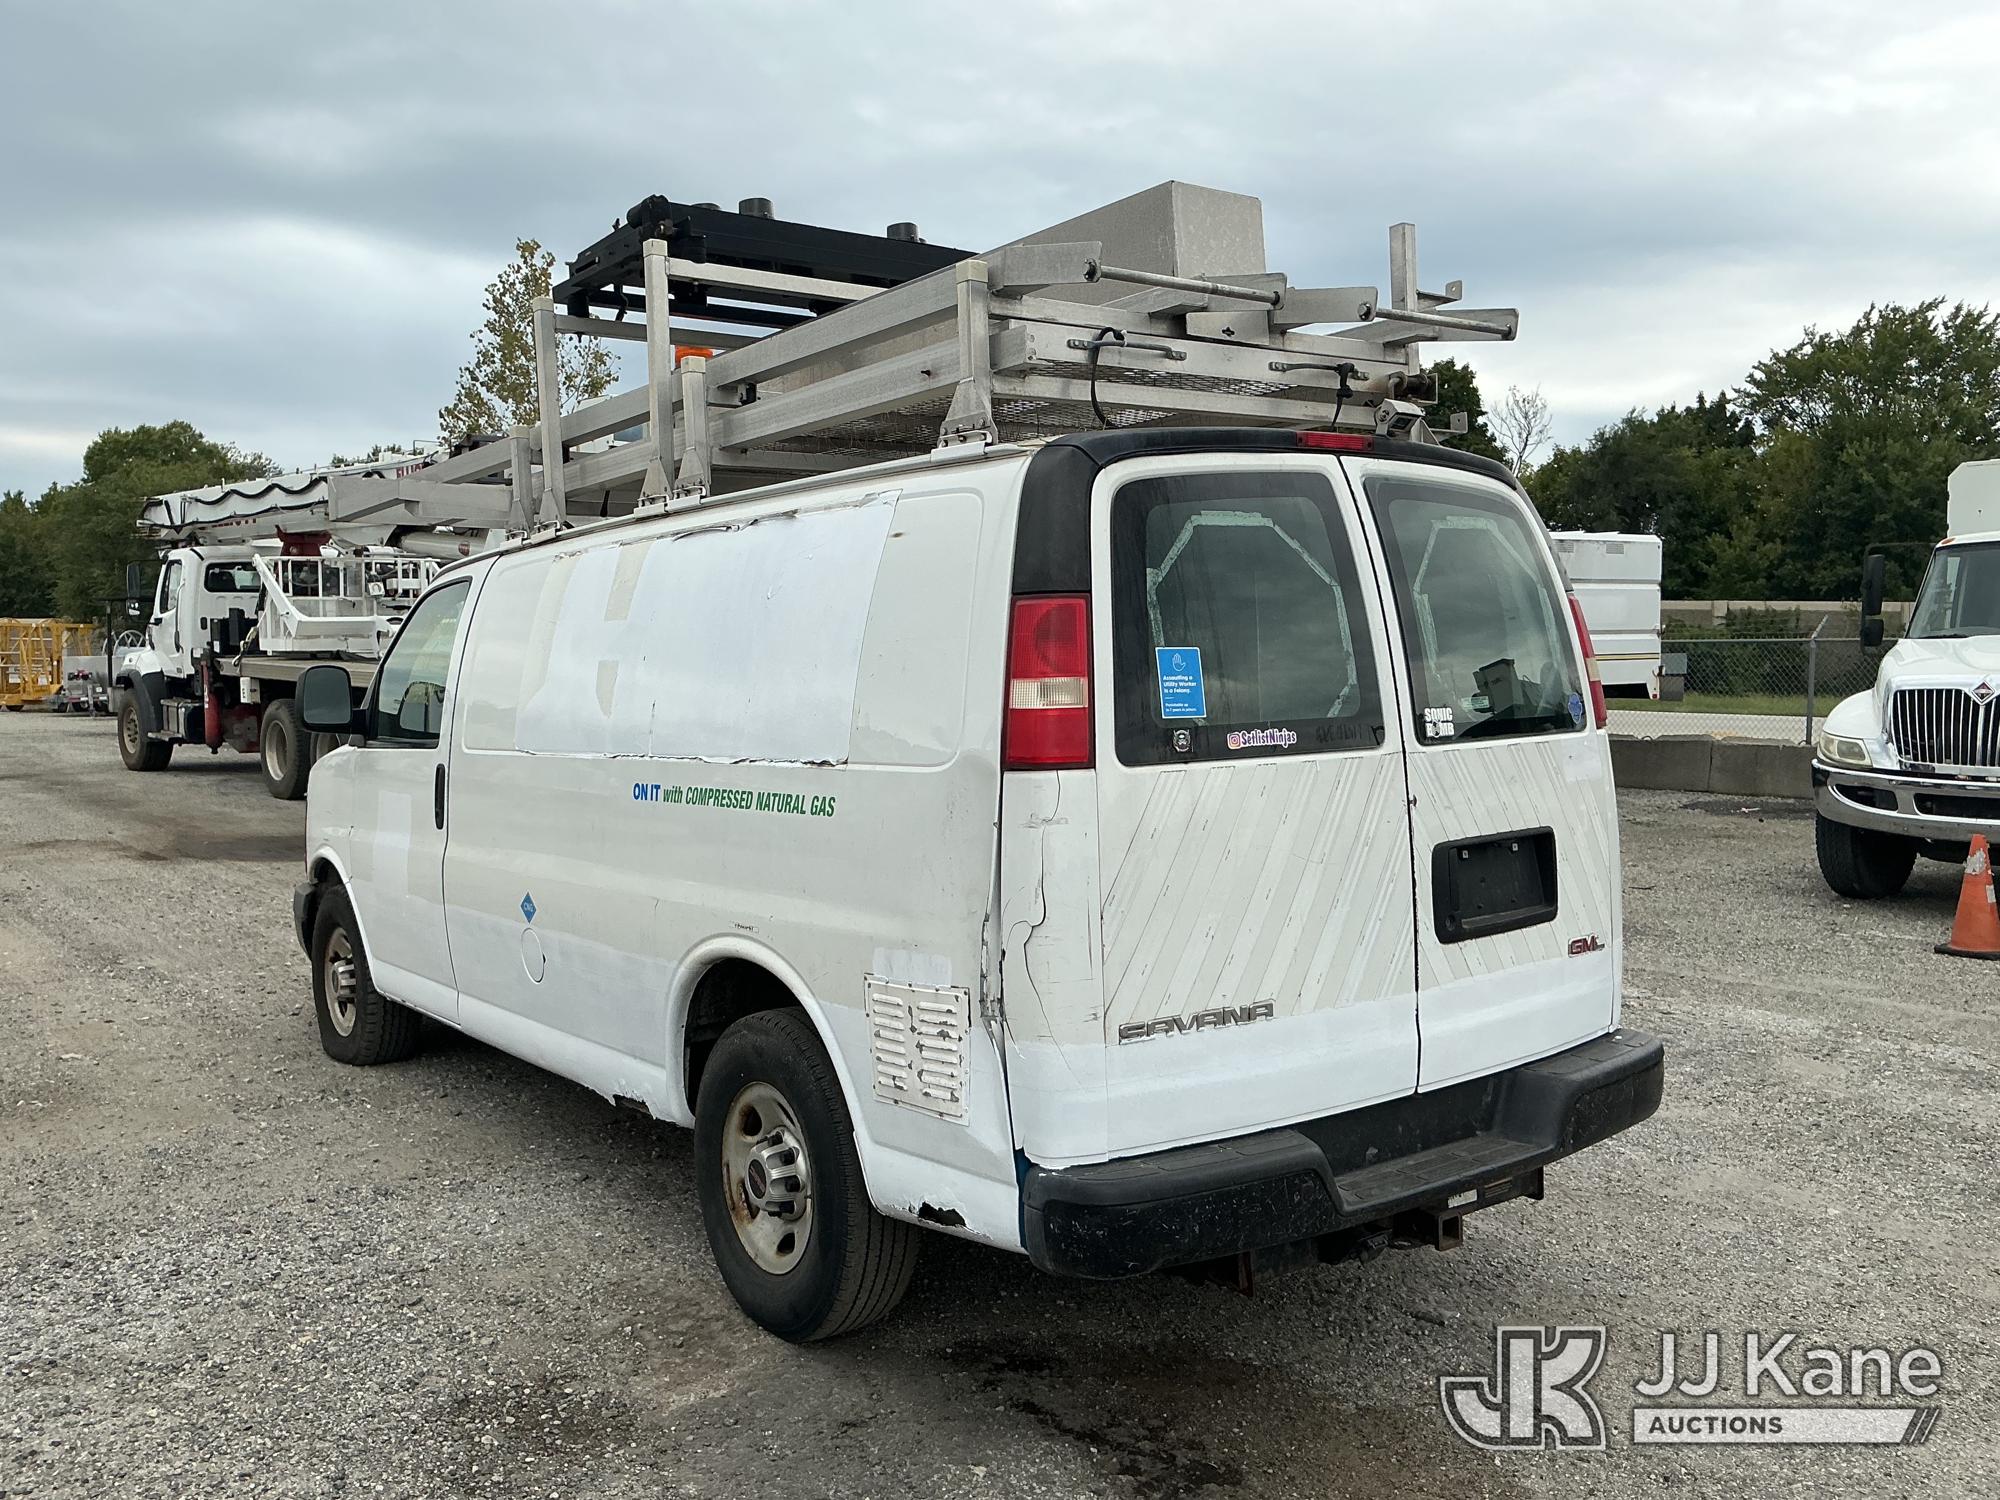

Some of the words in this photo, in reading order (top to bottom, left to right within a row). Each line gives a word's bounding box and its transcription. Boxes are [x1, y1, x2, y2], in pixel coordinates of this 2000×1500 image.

[1424, 707, 1453, 723] SONIC
[1425, 720, 1455, 738] BOMB
[633, 782, 649, 801] ON
[649, 783, 661, 803] IT
[662, 785, 684, 804] with
[685, 786, 753, 810] COMPRESSED
[755, 791, 807, 815] NATURAL
[810, 795, 836, 818] GAS
[1118, 998, 1276, 1045] SAVANA
